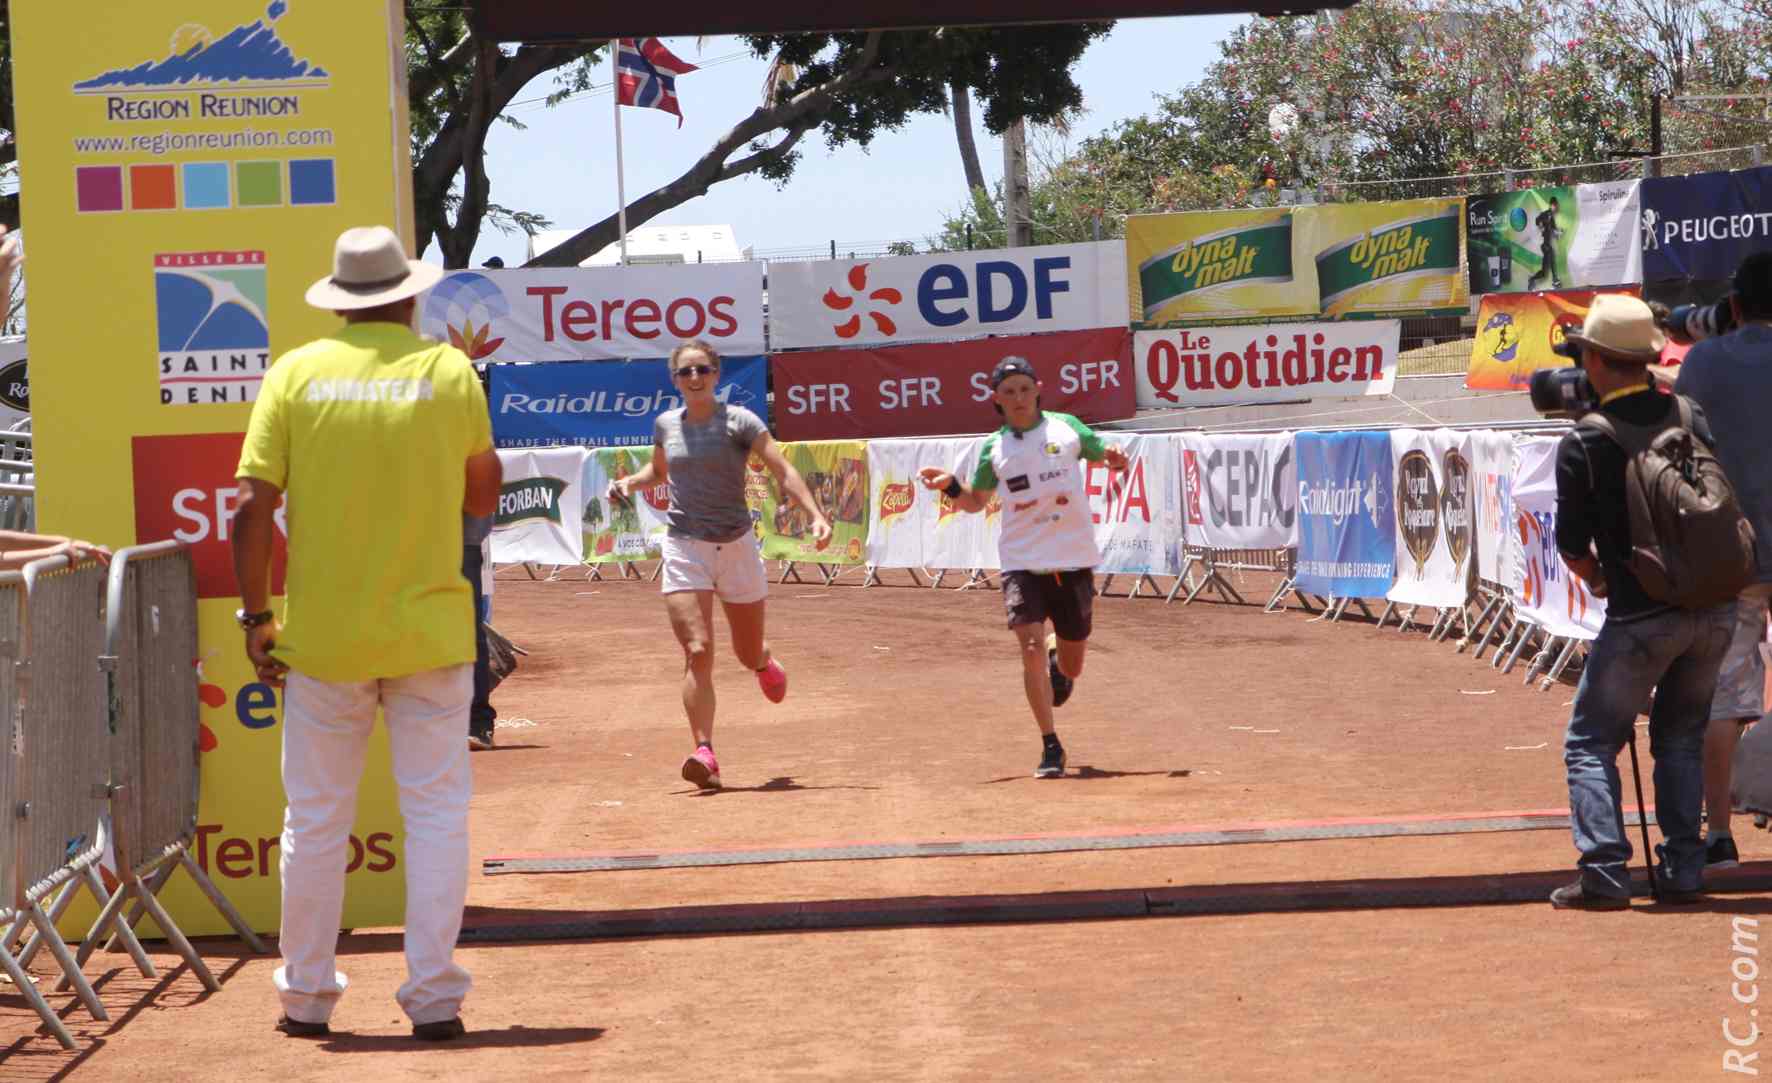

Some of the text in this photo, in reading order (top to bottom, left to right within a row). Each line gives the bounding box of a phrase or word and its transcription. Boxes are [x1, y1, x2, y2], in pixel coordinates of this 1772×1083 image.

[73, 128, 333, 154] www.regionreunion.com
[1350, 226, 1413, 268] dyna
[1664, 213, 1772, 244] PEUGEOT
[161, 252, 260, 265] VILLE DE
[1172, 235, 1237, 278] dyna
[1195, 245, 1258, 289] malt
[1372, 236, 1430, 280] malt
[526, 285, 738, 342] Tereos
[1180, 331, 1210, 350] Le
[162, 353, 269, 374] SAINT
[1147, 333, 1384, 403] Quotidien
[160, 386, 247, 404] DENI
[787, 383, 851, 415] SFR
[878, 377, 943, 410] SFR
[1060, 360, 1121, 394] SFR
[573, 436, 609, 446] TRAIL
[614, 435, 655, 446] RUNNI
[499, 486, 553, 516] FORBAN
[1206, 446, 1295, 529] CEPAC
[195, 823, 397, 879] Ters
